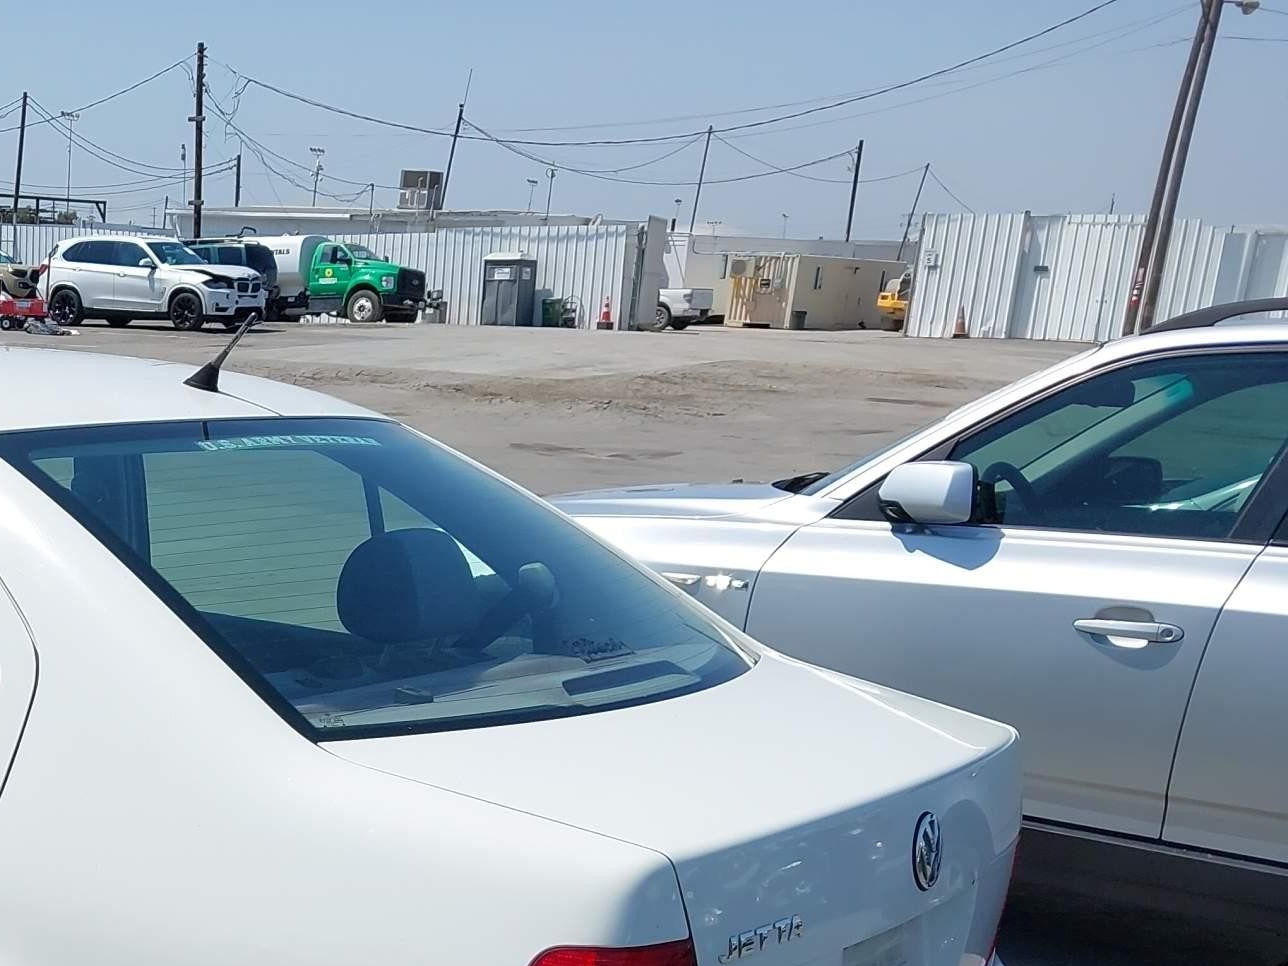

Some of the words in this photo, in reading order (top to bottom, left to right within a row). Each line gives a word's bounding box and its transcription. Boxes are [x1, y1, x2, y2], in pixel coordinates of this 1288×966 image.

[241, 435, 296, 447] ARMY
[295, 435, 382, 447] VETERAN
[718, 914, 805, 965] JETTA
